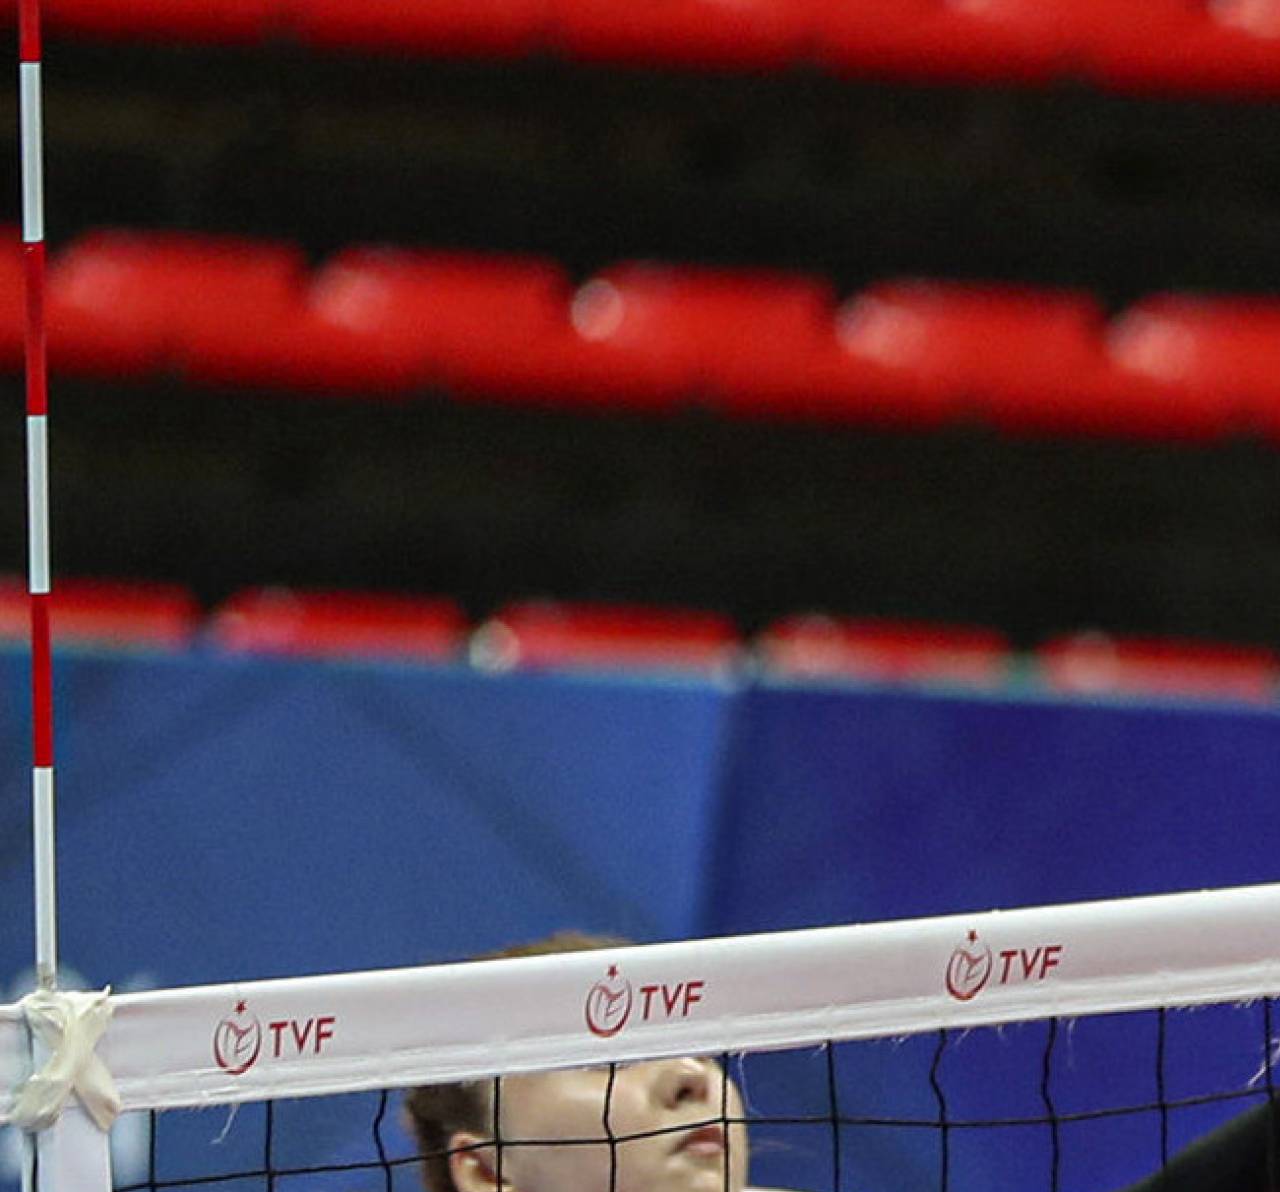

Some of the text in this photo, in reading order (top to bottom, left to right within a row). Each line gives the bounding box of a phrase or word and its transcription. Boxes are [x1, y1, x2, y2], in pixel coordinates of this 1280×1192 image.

[1000, 945, 1063, 984] TVF
[641, 980, 706, 1021] TVF
[269, 1016, 336, 1058] TVF
